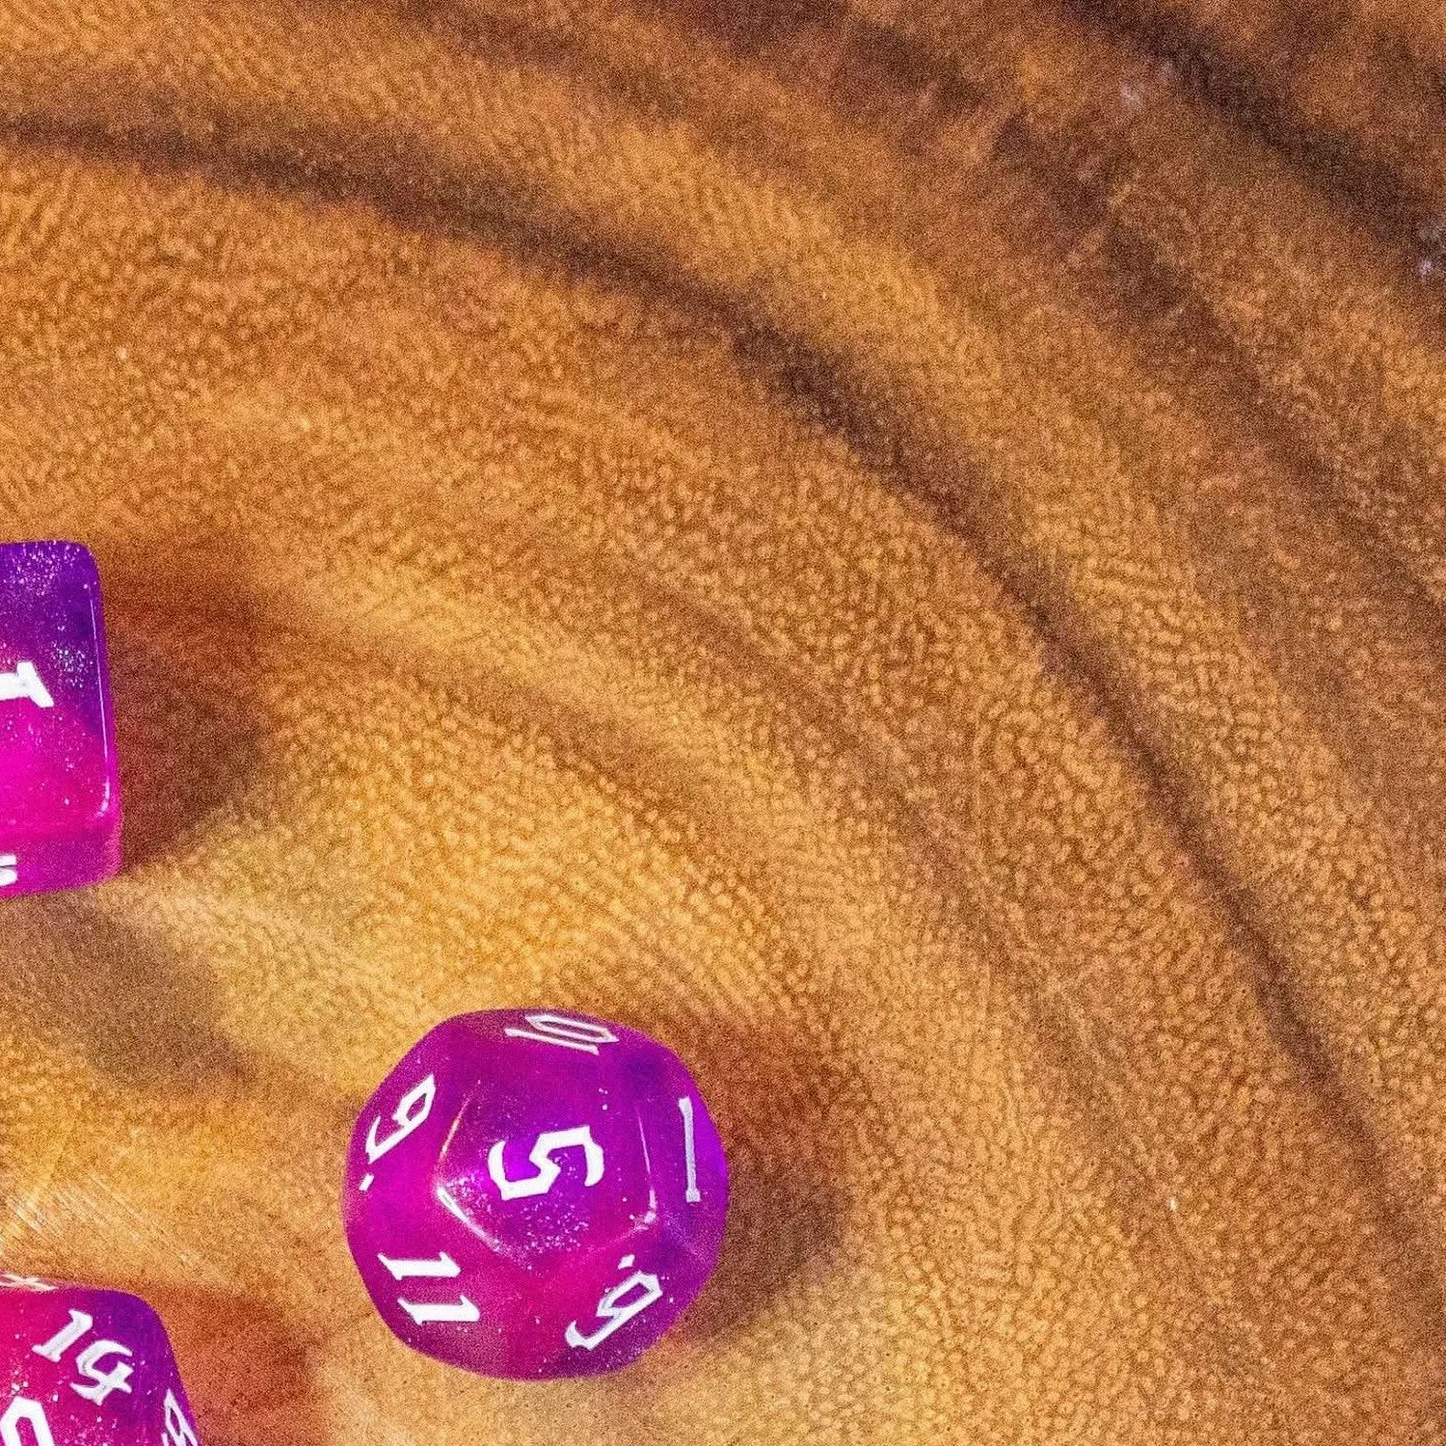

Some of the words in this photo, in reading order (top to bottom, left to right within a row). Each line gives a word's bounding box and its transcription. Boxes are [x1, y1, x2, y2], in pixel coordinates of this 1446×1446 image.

[505, 1013, 620, 1056] 10
[487, 1125, 605, 1201] 5
[377, 1251, 481, 1326] 11
[32, 1309, 135, 1406] 14
